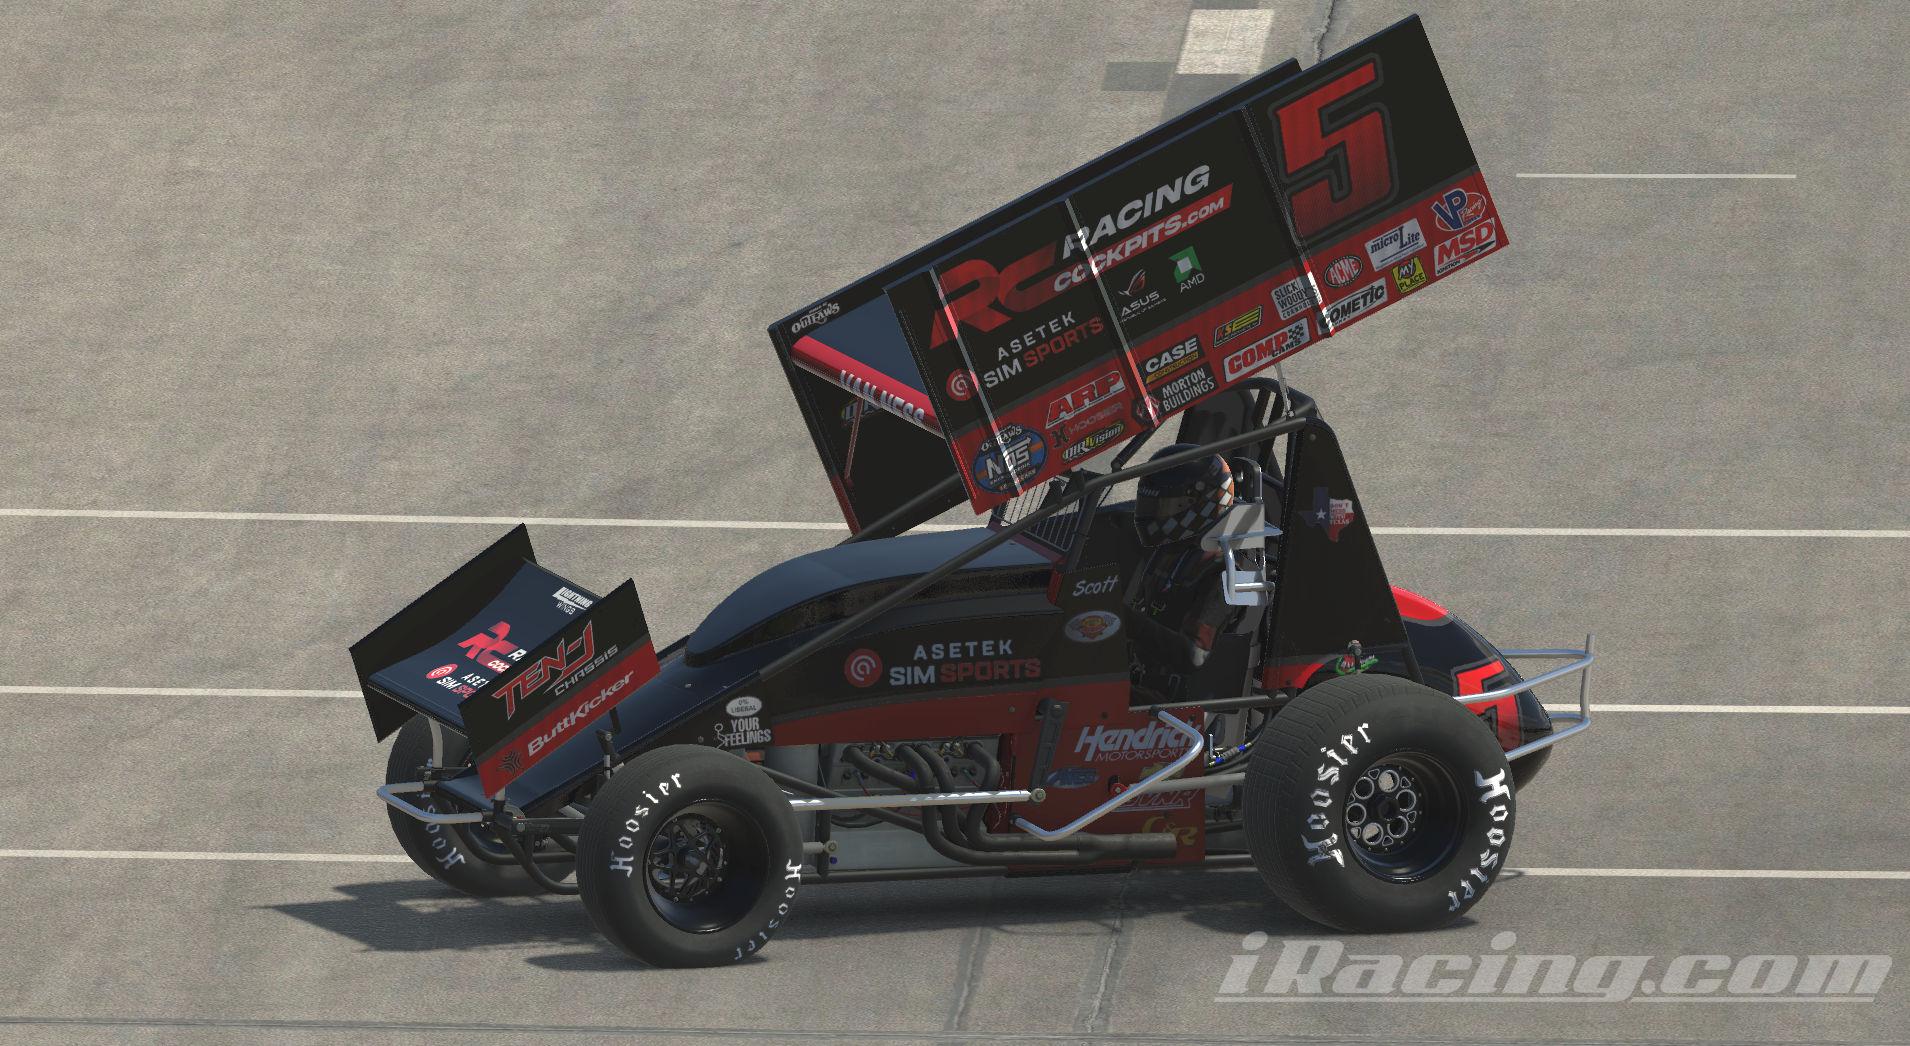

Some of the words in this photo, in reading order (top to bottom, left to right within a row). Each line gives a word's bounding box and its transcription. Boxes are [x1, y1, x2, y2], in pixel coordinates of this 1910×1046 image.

[1270, 54, 1399, 243] 5
[1063, 165, 1210, 260] RACING
[1432, 188, 1468, 231] VP
[1053, 197, 1225, 292] COCKPITS.COM
[1437, 221, 1494, 266] MSD
[1180, 272, 1205, 293] AMD
[1274, 281, 1298, 300] SLICK
[1329, 257, 1360, 285] ACME
[1399, 273, 1424, 289] PLACE
[929, 241, 1057, 349] RC
[1121, 290, 1160, 316] ASUS
[983, 359, 1023, 388] SIM
[1023, 317, 1104, 368] SPORTS
[998, 311, 1076, 361] ASETEK
[1145, 337, 1198, 373] CASE
[1228, 331, 1289, 375] COMP
[1047, 371, 1125, 428] ARP
[1162, 368, 1206, 398] MORTON
[1163, 376, 1215, 411] BUILDINGS
[1072, 574, 1119, 596] Scott
[555, 644, 618, 697] CHASSIS
[889, 666, 936, 686] SIM
[940, 658, 1041, 684] SPORTS
[913, 639, 1013, 661] ASETEK
[528, 669, 635, 757] ButtKicker
[731, 717, 760, 733] YOUR
[725, 729, 772, 747] FEELINGS
[1301, 722, 1370, 867] Hoosier
[610, 772, 682, 878] Hoosier
[1448, 768, 1512, 912] Hoosier
[734, 859, 802, 961] Hoosier
